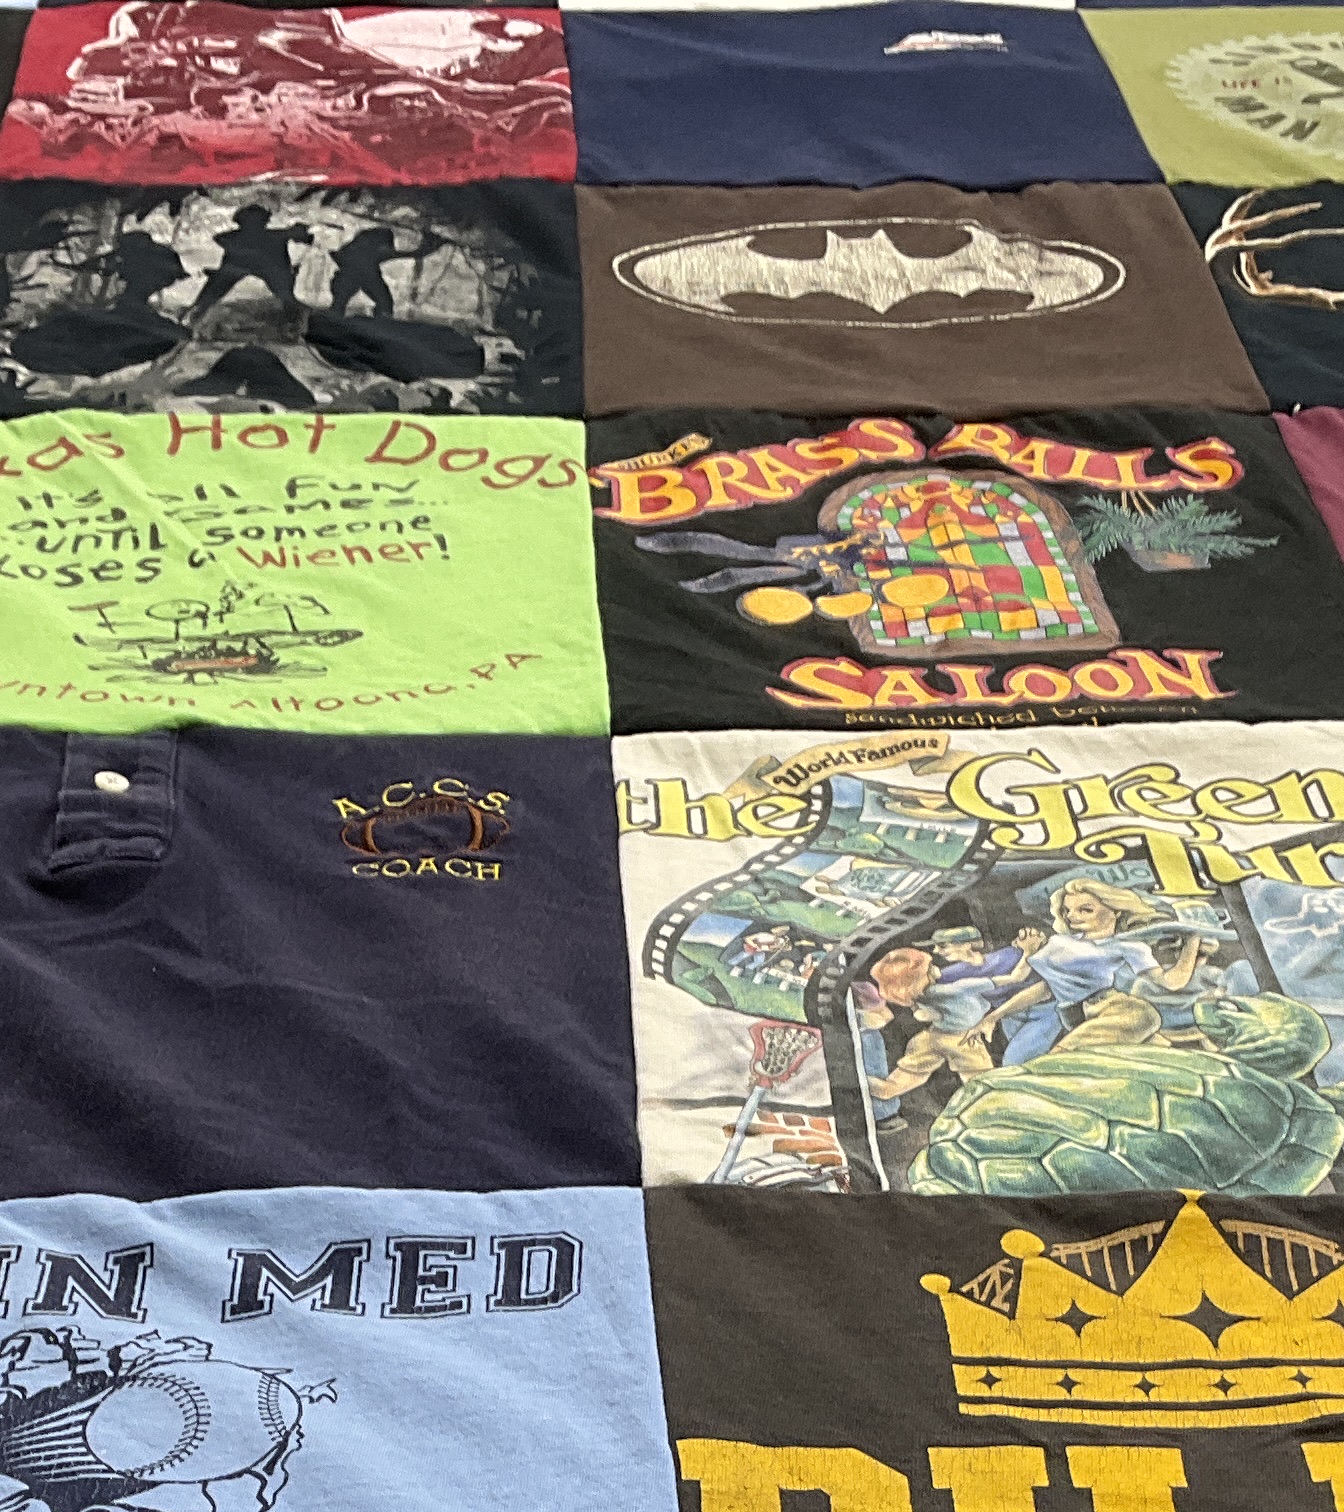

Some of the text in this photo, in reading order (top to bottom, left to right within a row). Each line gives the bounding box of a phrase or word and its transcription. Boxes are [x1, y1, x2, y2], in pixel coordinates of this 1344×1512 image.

[167, 412, 336, 454] Hot
[365, 420, 586, 490] Dogs
[593, 418, 926, 524] BRASS
[202, 514, 432, 547] someone
[236, 534, 451, 570] Wiener!
[766, 649, 1238, 710] SALOON
[772, 734, 941, 791] World Famous
[614, 777, 819, 841] the
[351, 856, 502, 882] COACH
[220, 1230, 584, 1321] MED
